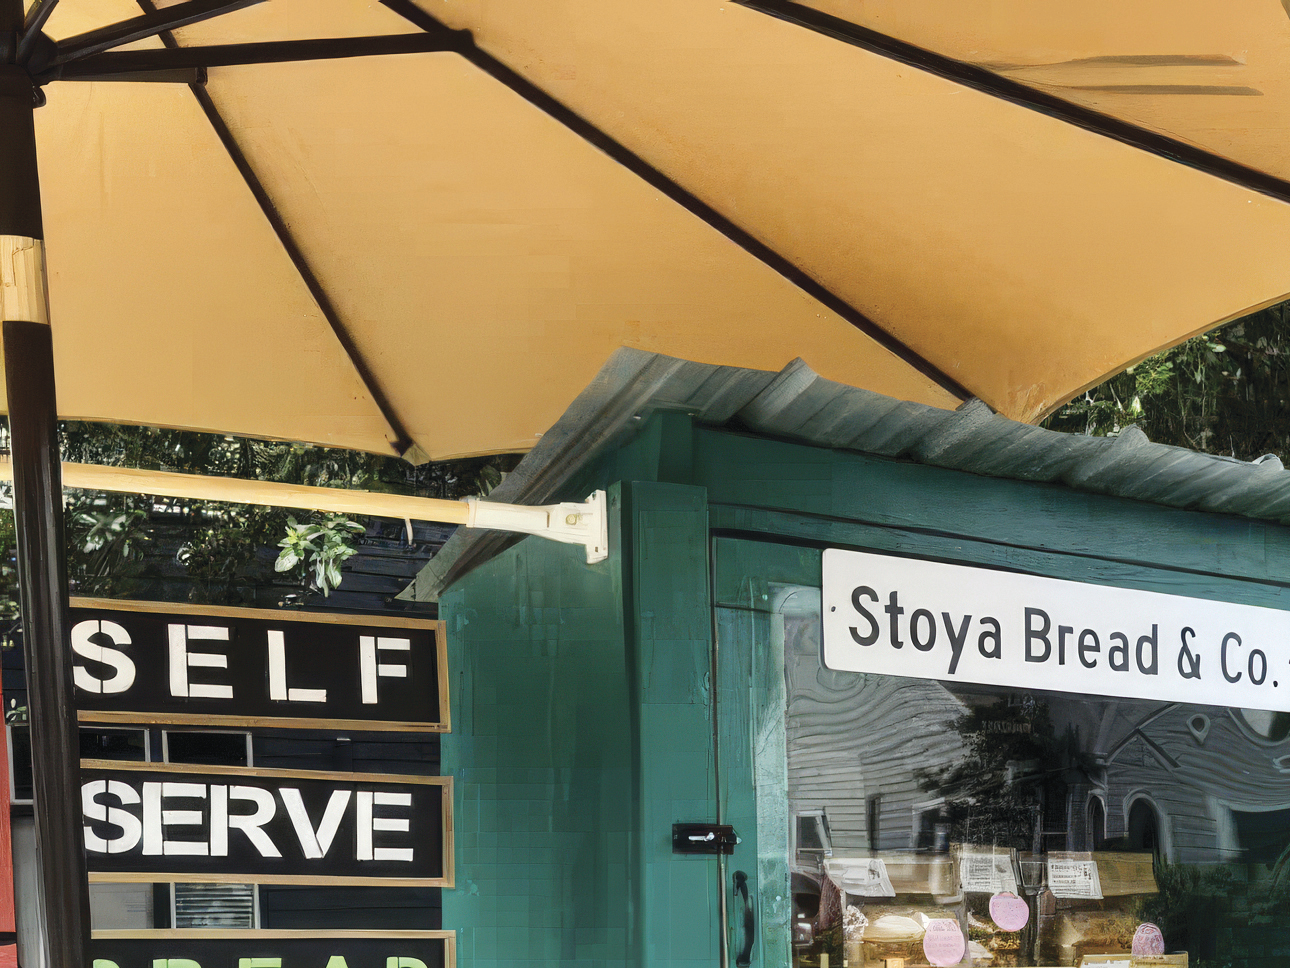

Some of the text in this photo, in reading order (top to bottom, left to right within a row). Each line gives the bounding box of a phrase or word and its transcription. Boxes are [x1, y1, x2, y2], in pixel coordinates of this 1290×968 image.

[71, 619, 411, 704] SELF
[848, 585, 1279, 688] Stoya Bread & Co.
[81, 779, 414, 862] SERVE
